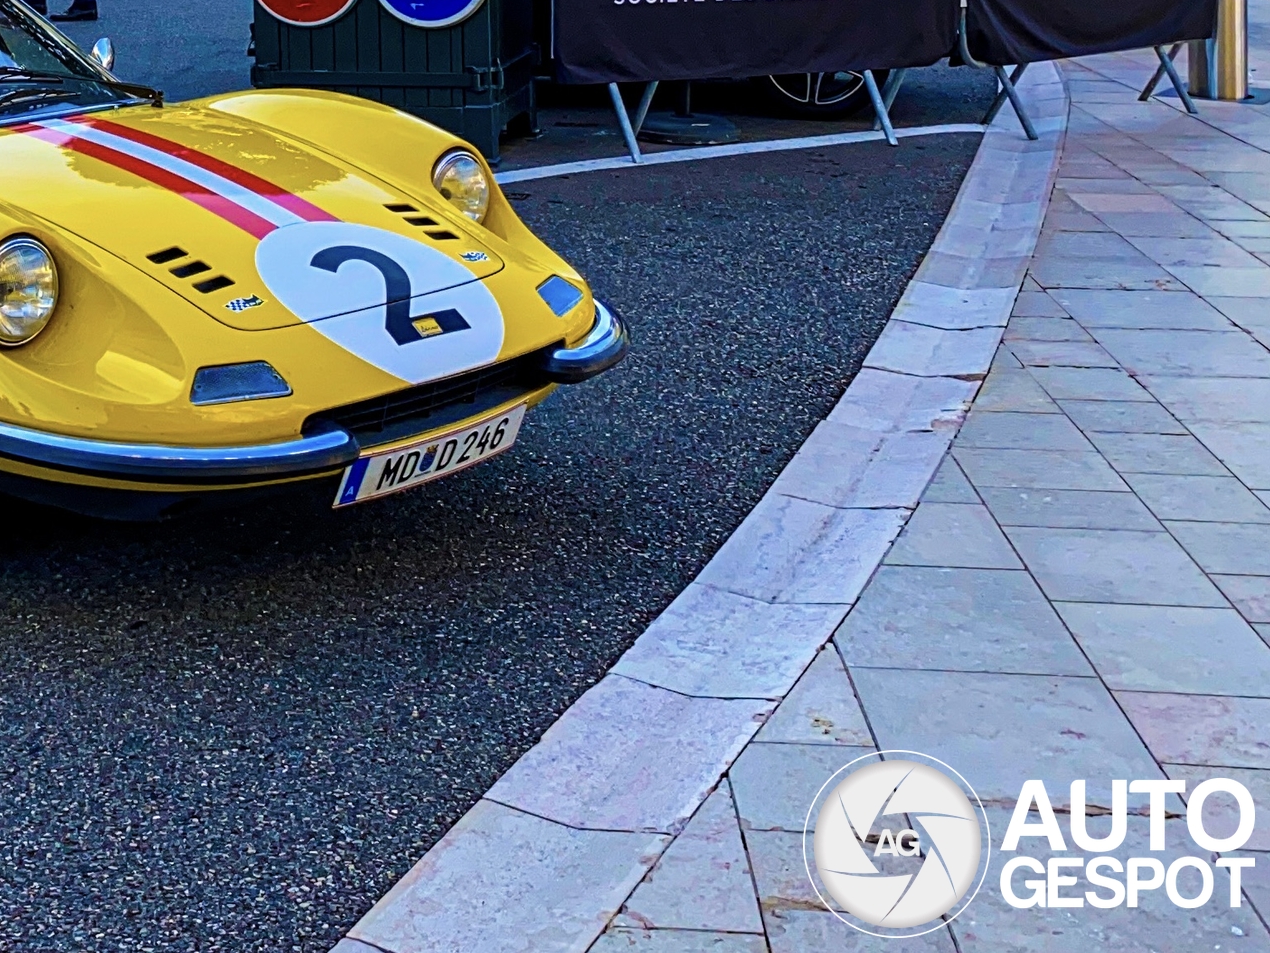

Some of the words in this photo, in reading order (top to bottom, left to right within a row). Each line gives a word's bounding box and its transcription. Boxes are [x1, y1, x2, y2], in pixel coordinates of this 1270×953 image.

[309, 244, 472, 347] 2
[344, 485, 354, 497] A
[376, 450, 421, 491] MD
